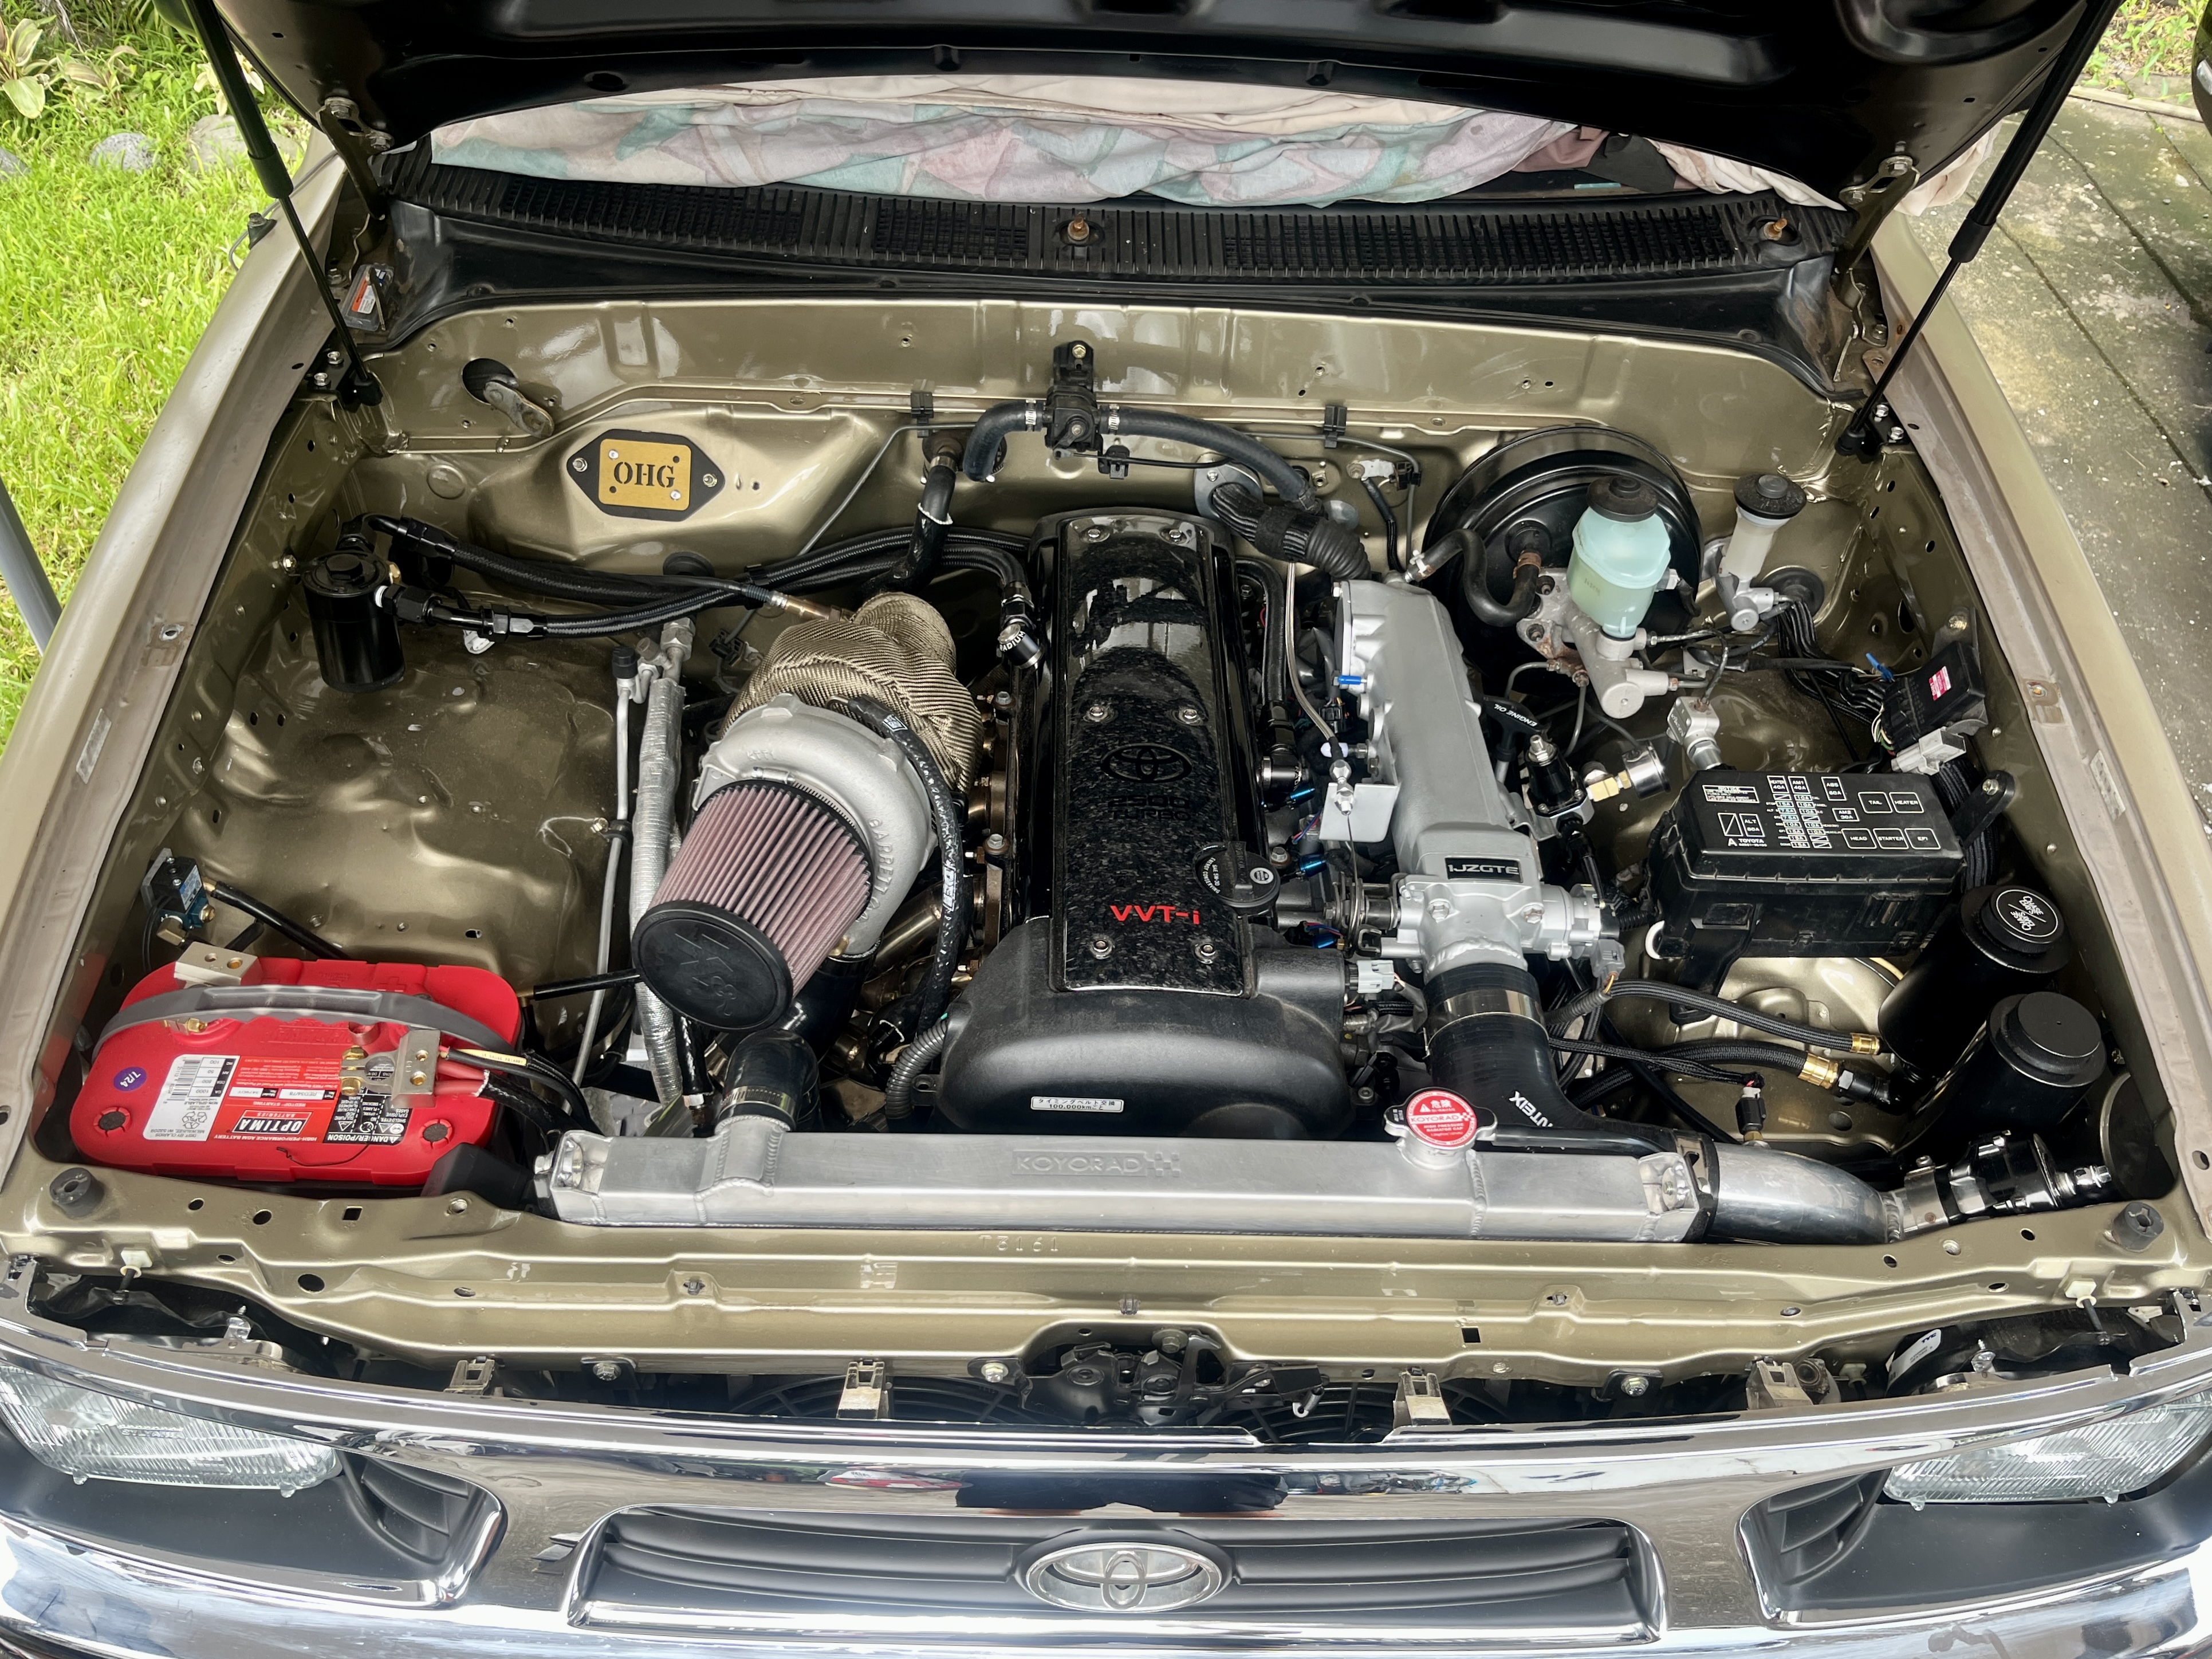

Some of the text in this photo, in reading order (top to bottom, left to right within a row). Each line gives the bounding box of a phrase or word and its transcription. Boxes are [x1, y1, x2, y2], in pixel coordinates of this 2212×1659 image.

[613, 462, 675, 488] OHG
[999, 631, 1026, 652] RADIUM
[1494, 703, 1538, 727] ENGINE OIL
[1728, 838, 1738, 846] A
[868, 817, 894, 895] GARRETT
[1203, 857, 1221, 894] ENERGY CONSERVING
[1447, 864, 1520, 875] 1JZGTE
[2023, 896, 2044, 915] CHASE
[1110, 905, 1200, 925] VVT-i
[120, 1071, 141, 1087] 7/24
[1430, 1099, 1452, 1109] 危険
[238, 1119, 303, 1131] OPTIMA
[1411, 1114, 1459, 1123] KOYORAD
[1017, 1155, 1143, 1173] KOYORAD
